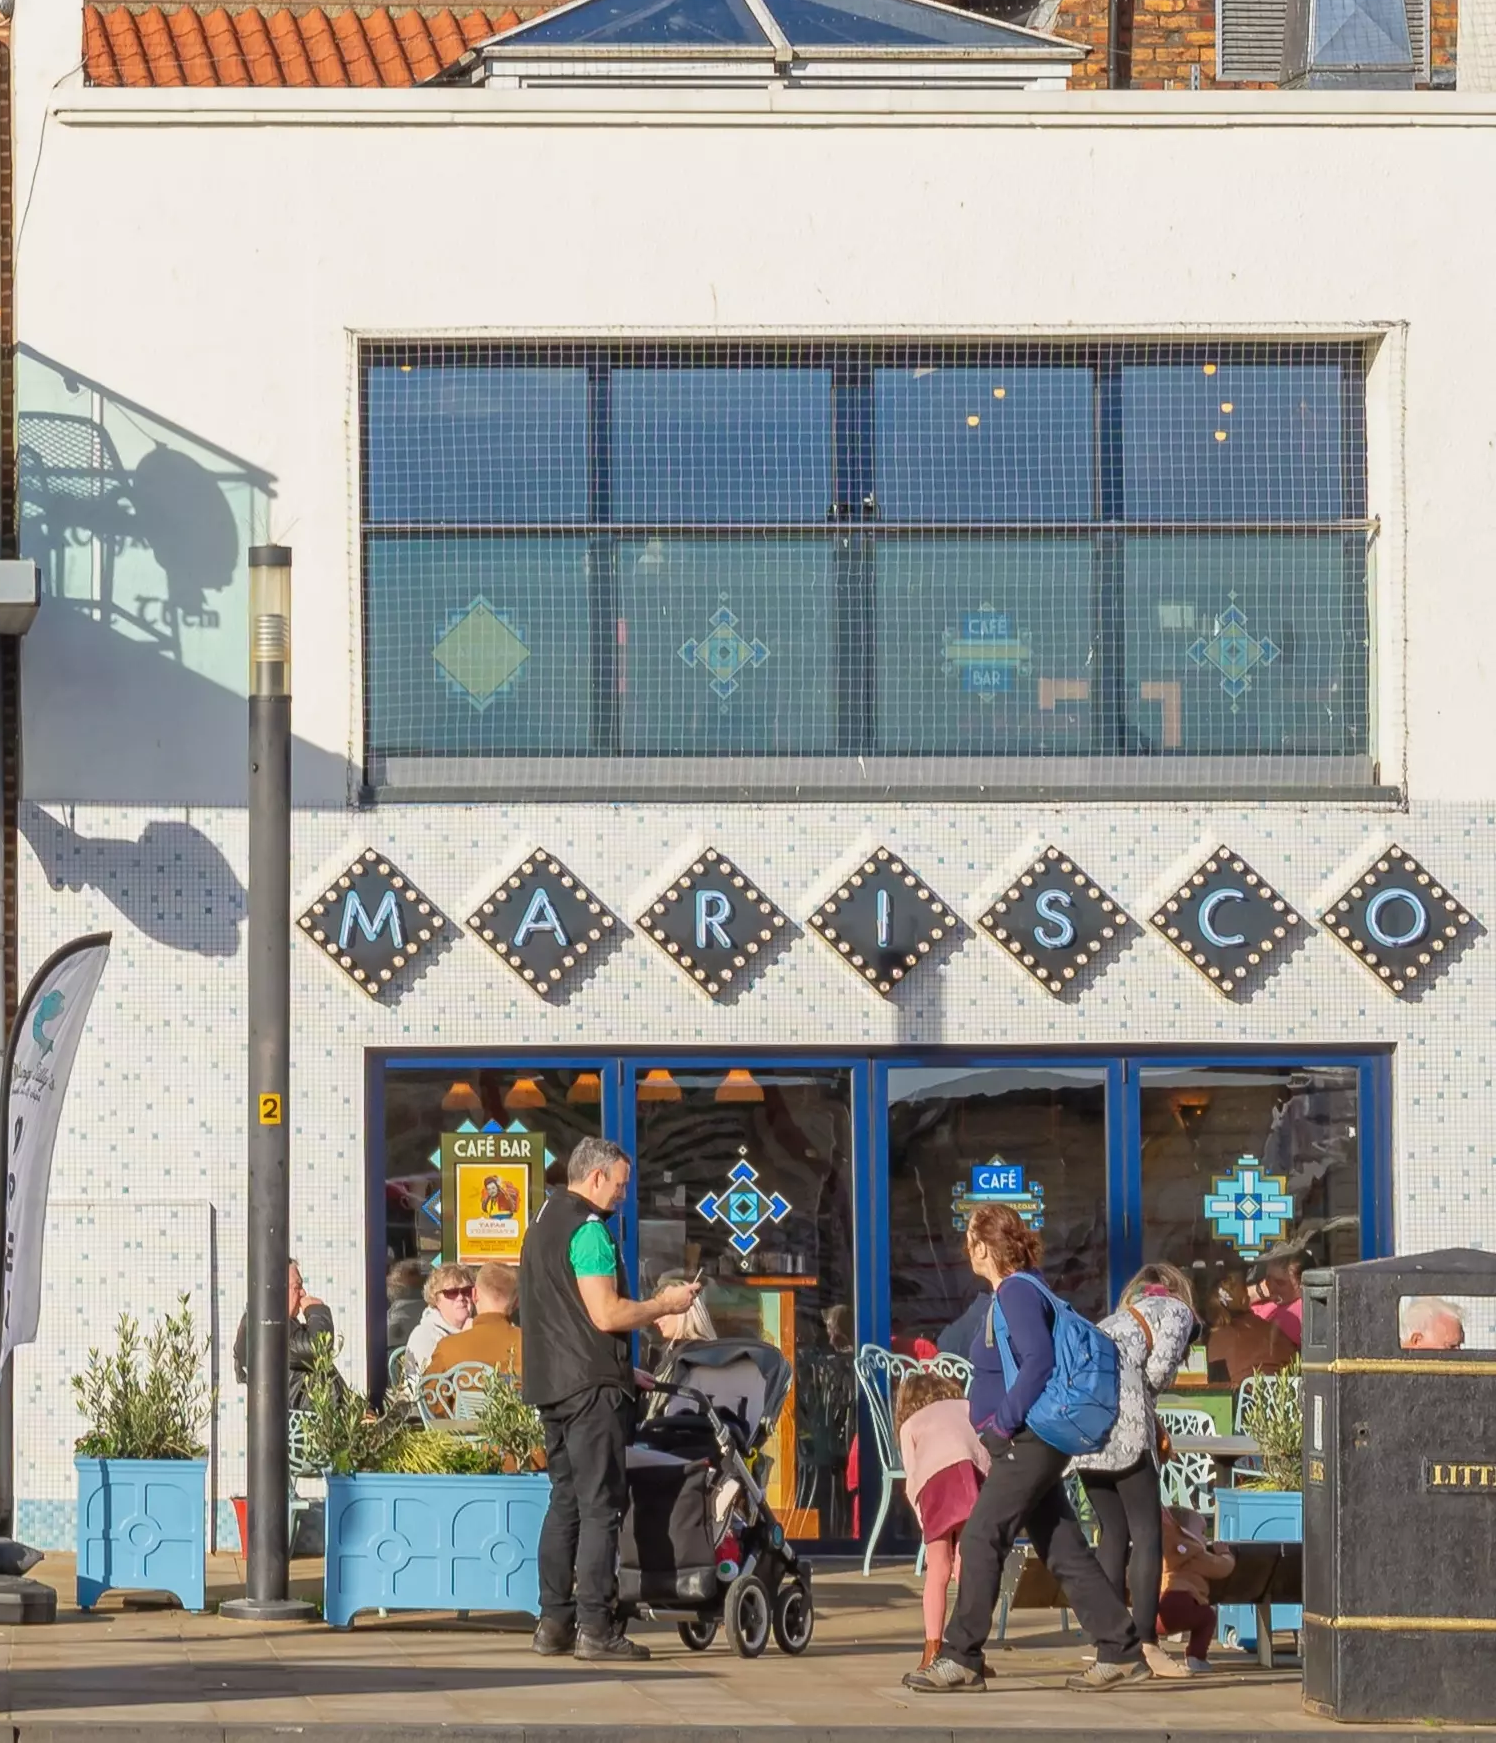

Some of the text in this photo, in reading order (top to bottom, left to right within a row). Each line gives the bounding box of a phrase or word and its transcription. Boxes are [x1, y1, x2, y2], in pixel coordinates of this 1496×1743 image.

[972, 669, 1001, 686] BAR
[340, 888, 1430, 951] MARISCO
[262, 1098, 278, 1119] 2
[454, 1135, 531, 1157] CAFÉ BAR
[978, 1168, 1017, 1189] CAFÉ
[1431, 1464, 1496, 1488] LITT
